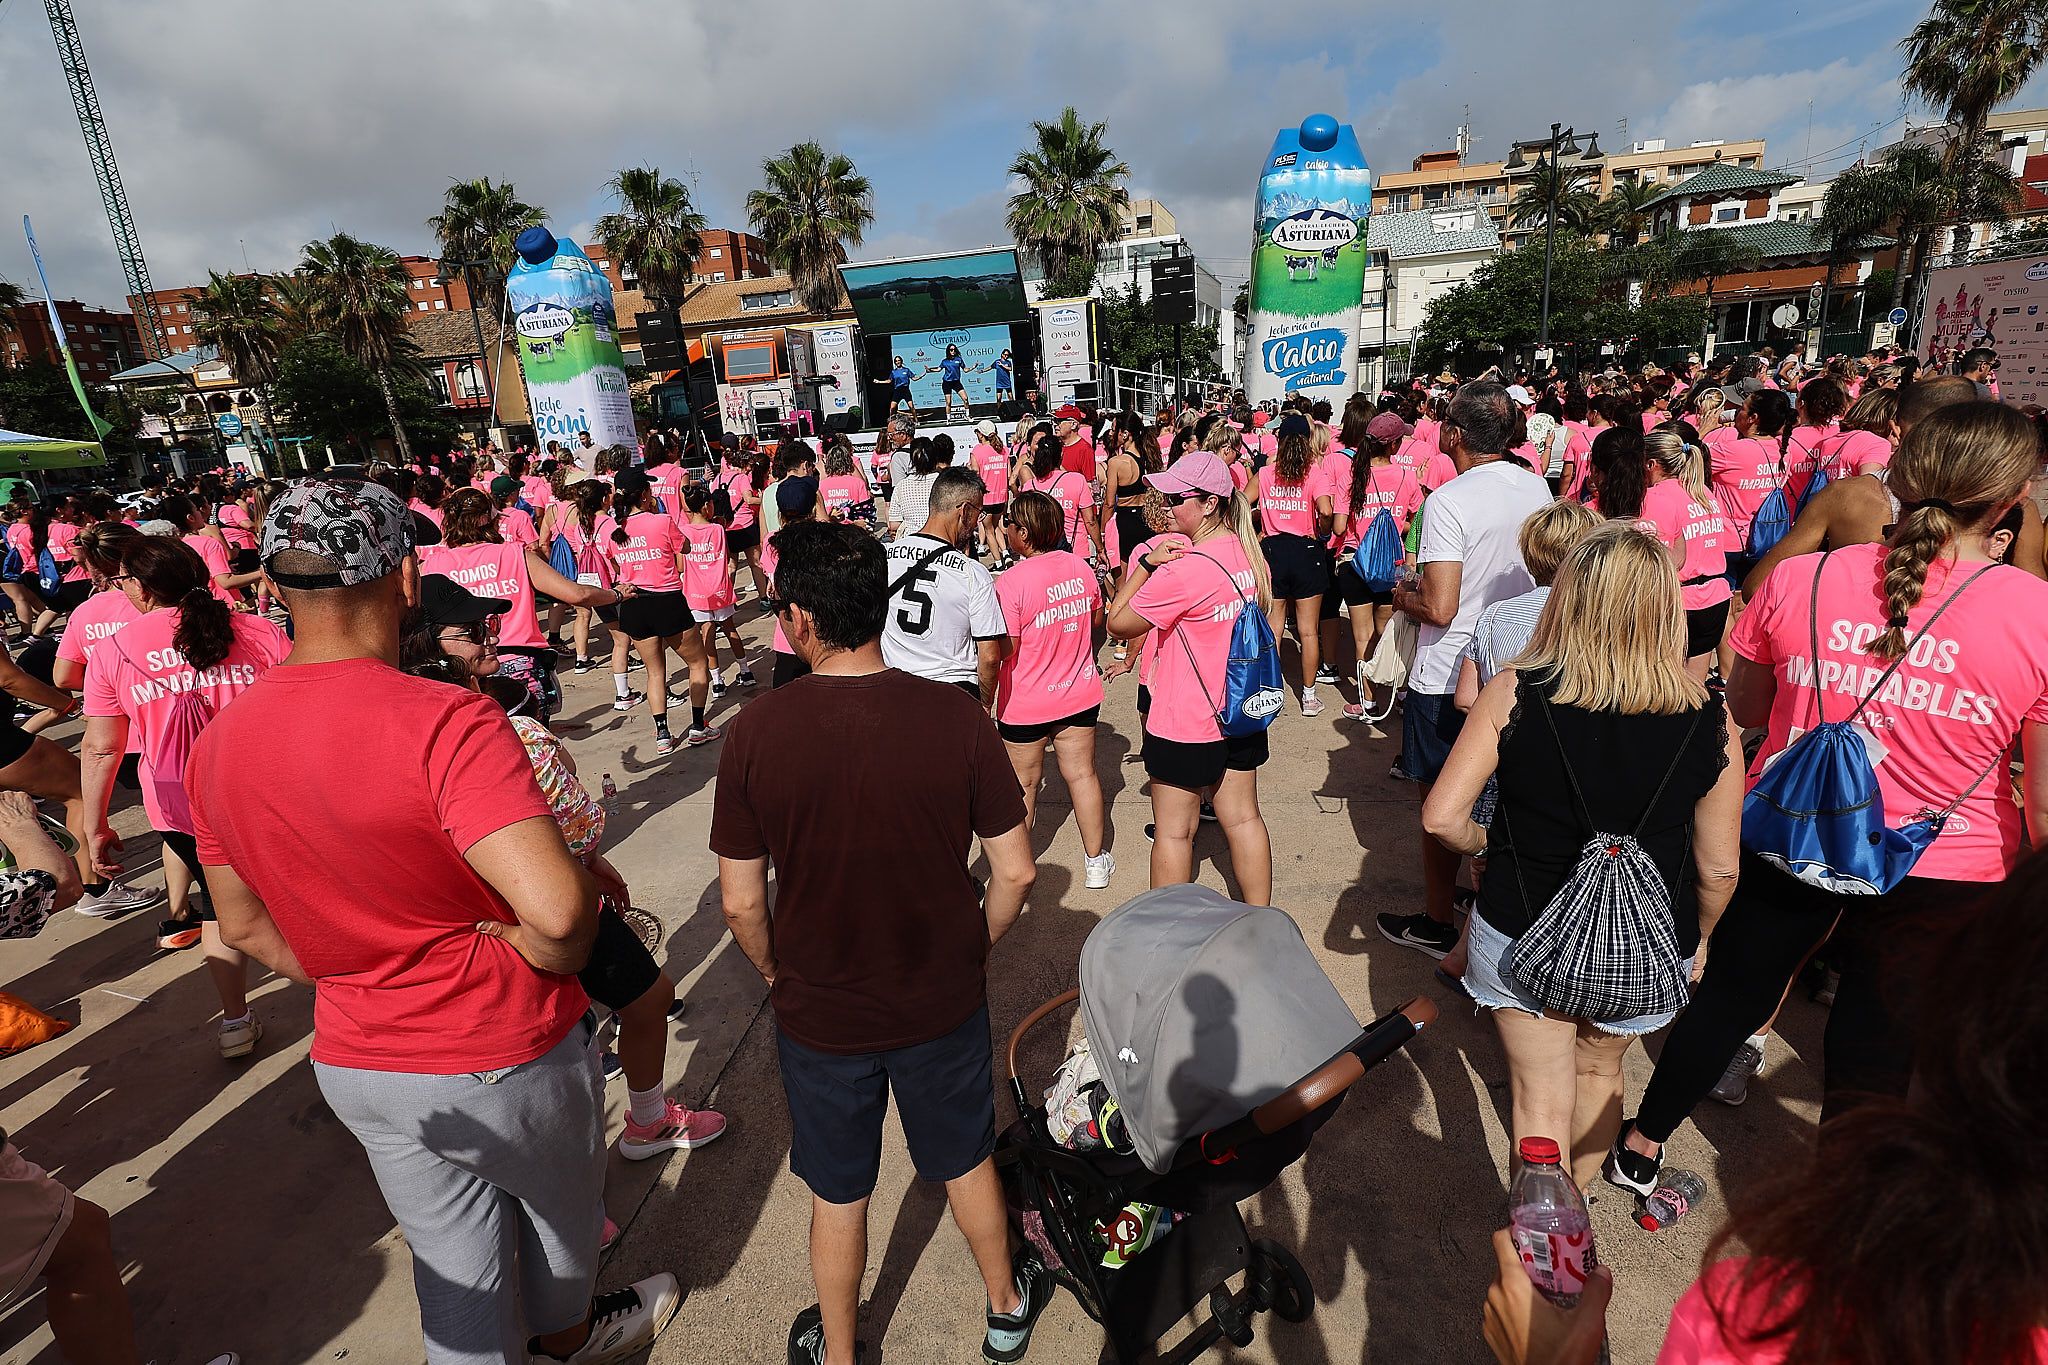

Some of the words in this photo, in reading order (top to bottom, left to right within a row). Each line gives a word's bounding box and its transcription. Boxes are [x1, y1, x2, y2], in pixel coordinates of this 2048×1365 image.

[1276, 226, 1351, 243] ASTURIANA
[2003, 287, 2029, 296] OYSHO
[1942, 310, 1975, 320] CARRERA
[518, 317, 571, 333] ASTURIANA
[1936, 323, 1974, 337] MUJER
[932, 335, 968, 345] ASTURIANA
[1051, 330, 1081, 340] OYSHO
[820, 350, 849, 359] OYSHO
[967, 347, 994, 357] OYSHO
[1053, 350, 1080, 358] Santander
[1268, 337, 1338, 373] Calcio
[1296, 369, 1334, 385] natural
[534, 396, 563, 415] Leche
[536, 407, 592, 439] semi
[828, 488, 849, 498] SOMOS
[1269, 486, 1302, 498] SOMOS
[887, 545, 967, 572] BECKENAUER
[450, 563, 497, 584] SOMOS
[1046, 577, 1085, 604] SOMOS
[896, 565, 940, 640] 5
[1063, 621, 1078, 633] 2026
[130, 664, 255, 706] IMPARABLES
[1047, 679, 1073, 692] OYSHO
[1787, 654, 1998, 726] IMPARABLES
